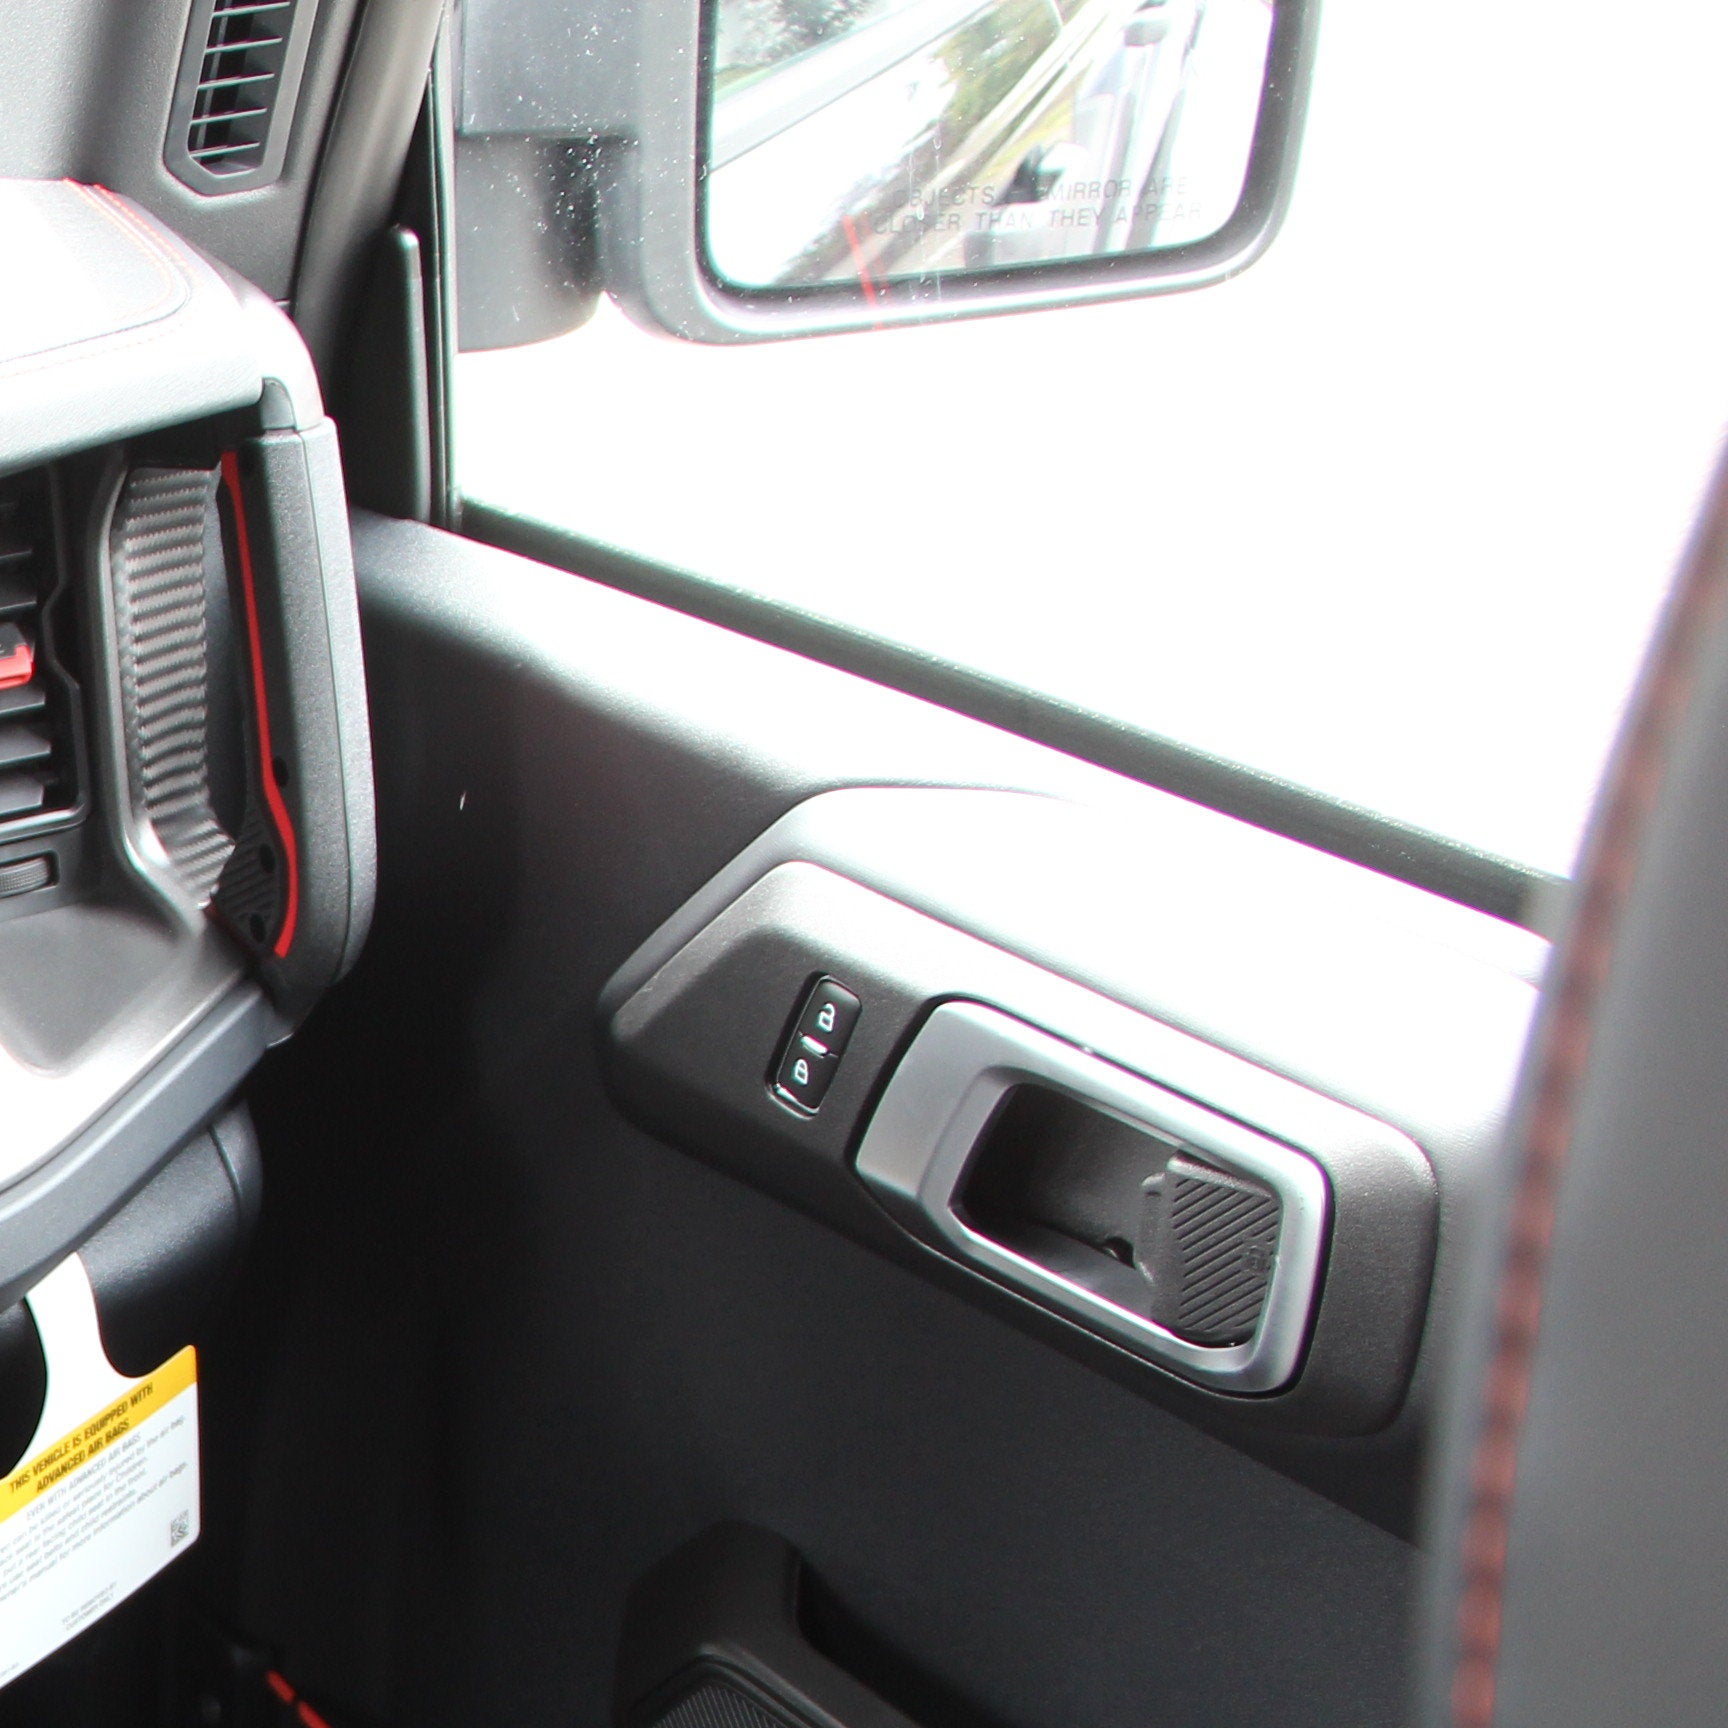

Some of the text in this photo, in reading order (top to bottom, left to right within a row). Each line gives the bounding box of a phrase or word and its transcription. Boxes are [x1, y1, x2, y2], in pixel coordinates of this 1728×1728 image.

[873, 211, 962, 235] CLOER
[1115, 202, 1204, 223] APEAR
[896, 184, 995, 208] BJECTS
[9, 1383, 153, 1492] THIS VEHICLE IS EQUIPPED WITH
[36, 1419, 129, 1490] ADVANCED AIR BAGS
